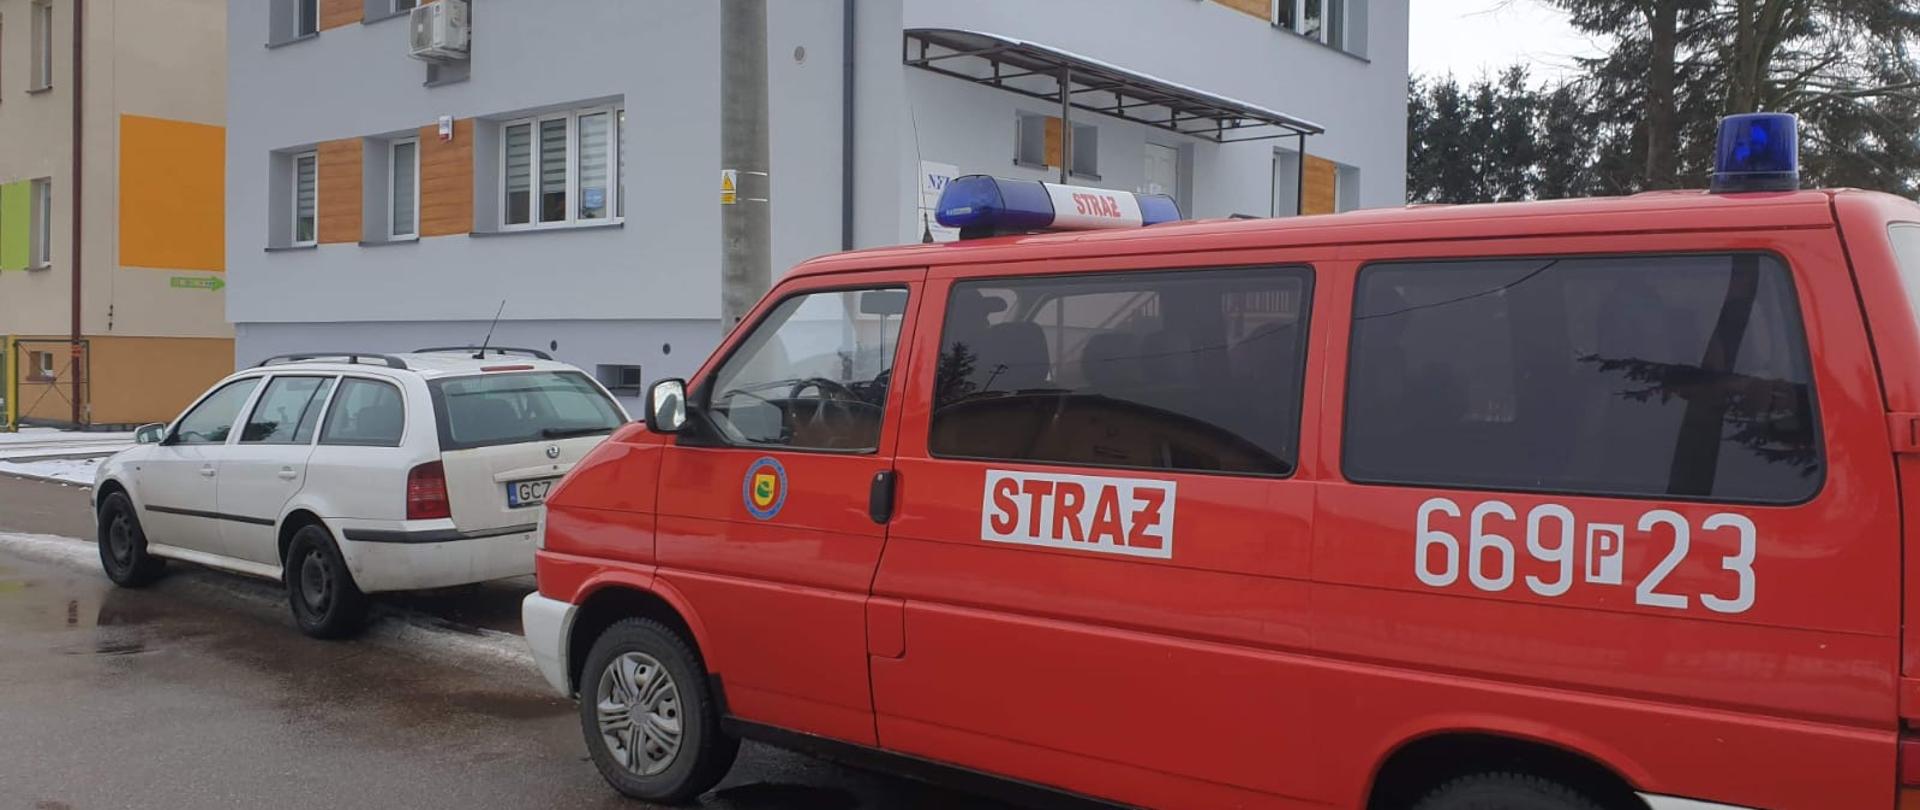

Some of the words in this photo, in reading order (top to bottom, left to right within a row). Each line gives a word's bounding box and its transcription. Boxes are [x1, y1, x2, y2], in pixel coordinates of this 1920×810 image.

[1415, 497, 1575, 597] 669
[1590, 528, 1620, 578] P
[1635, 509, 1757, 613] 23
